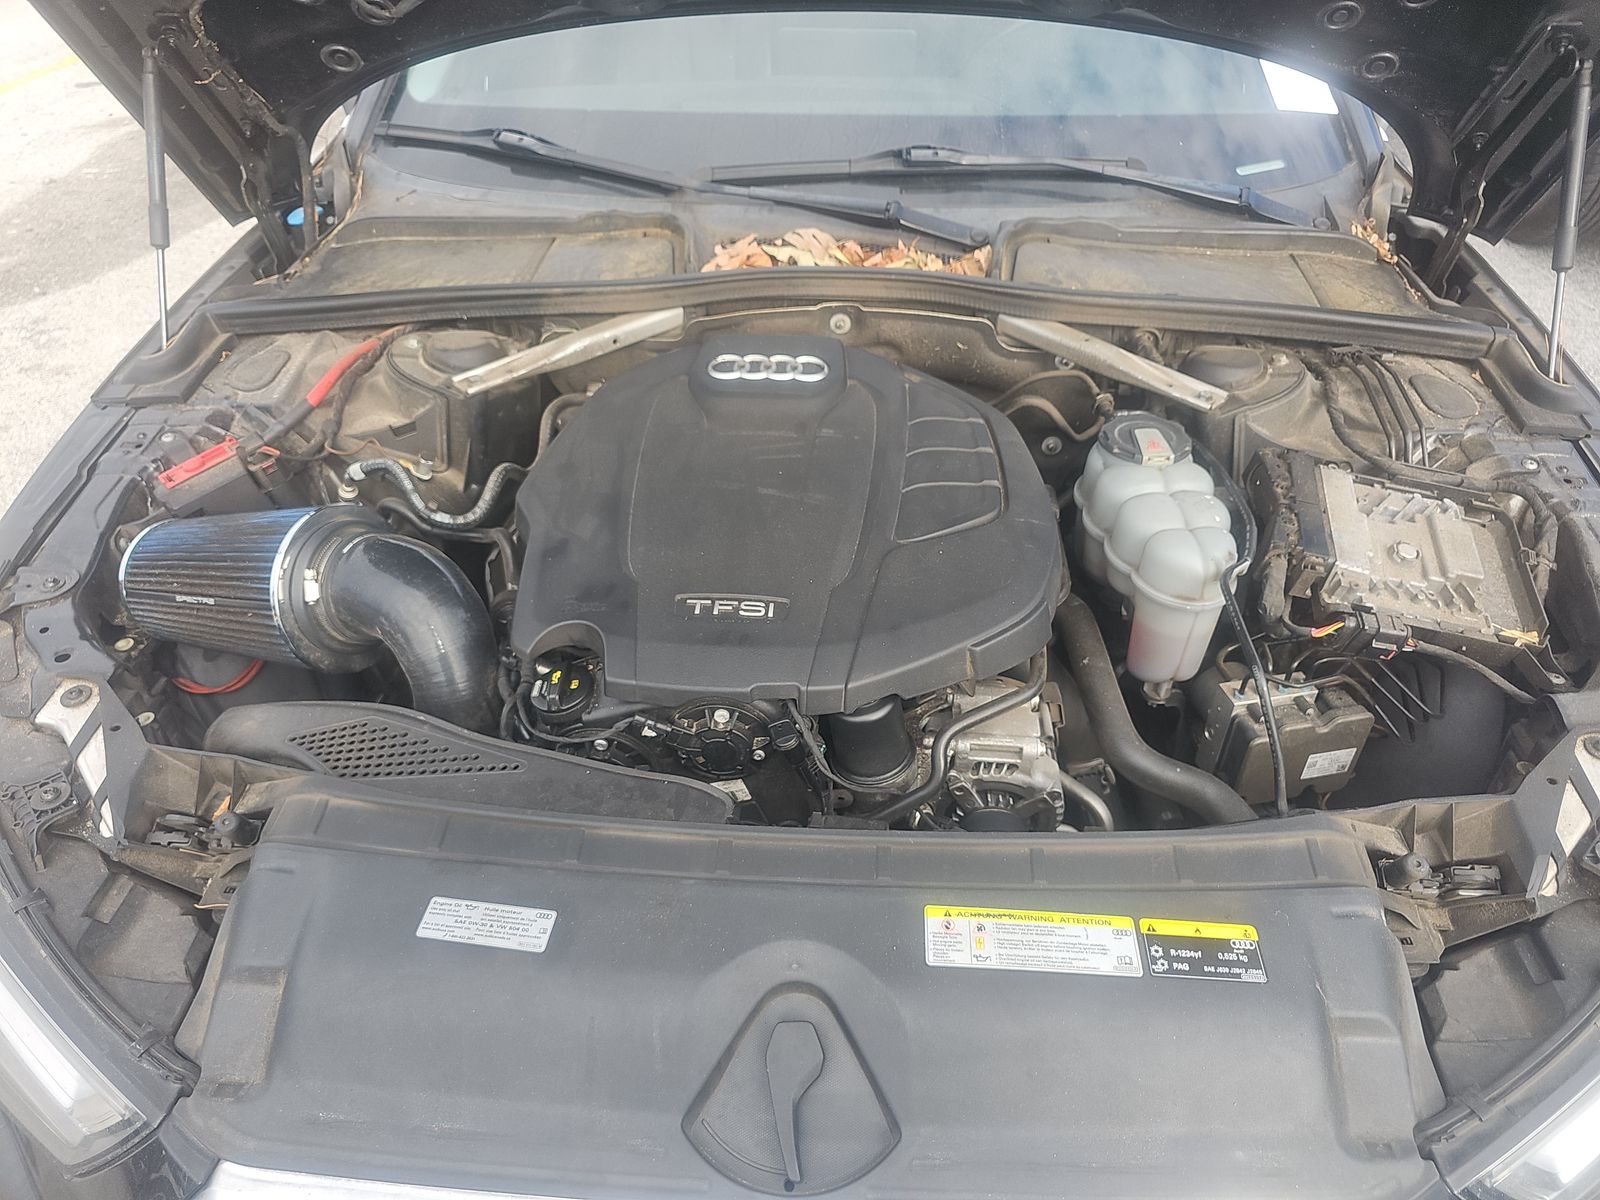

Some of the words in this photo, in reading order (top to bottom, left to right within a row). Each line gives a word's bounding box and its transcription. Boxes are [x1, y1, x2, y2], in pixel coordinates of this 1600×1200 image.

[686, 599, 775, 618] TFSI
[1059, 916, 1112, 926] ATTENTION
[1239, 953, 1249, 963] kg
[1173, 962, 1190, 971] PAG
